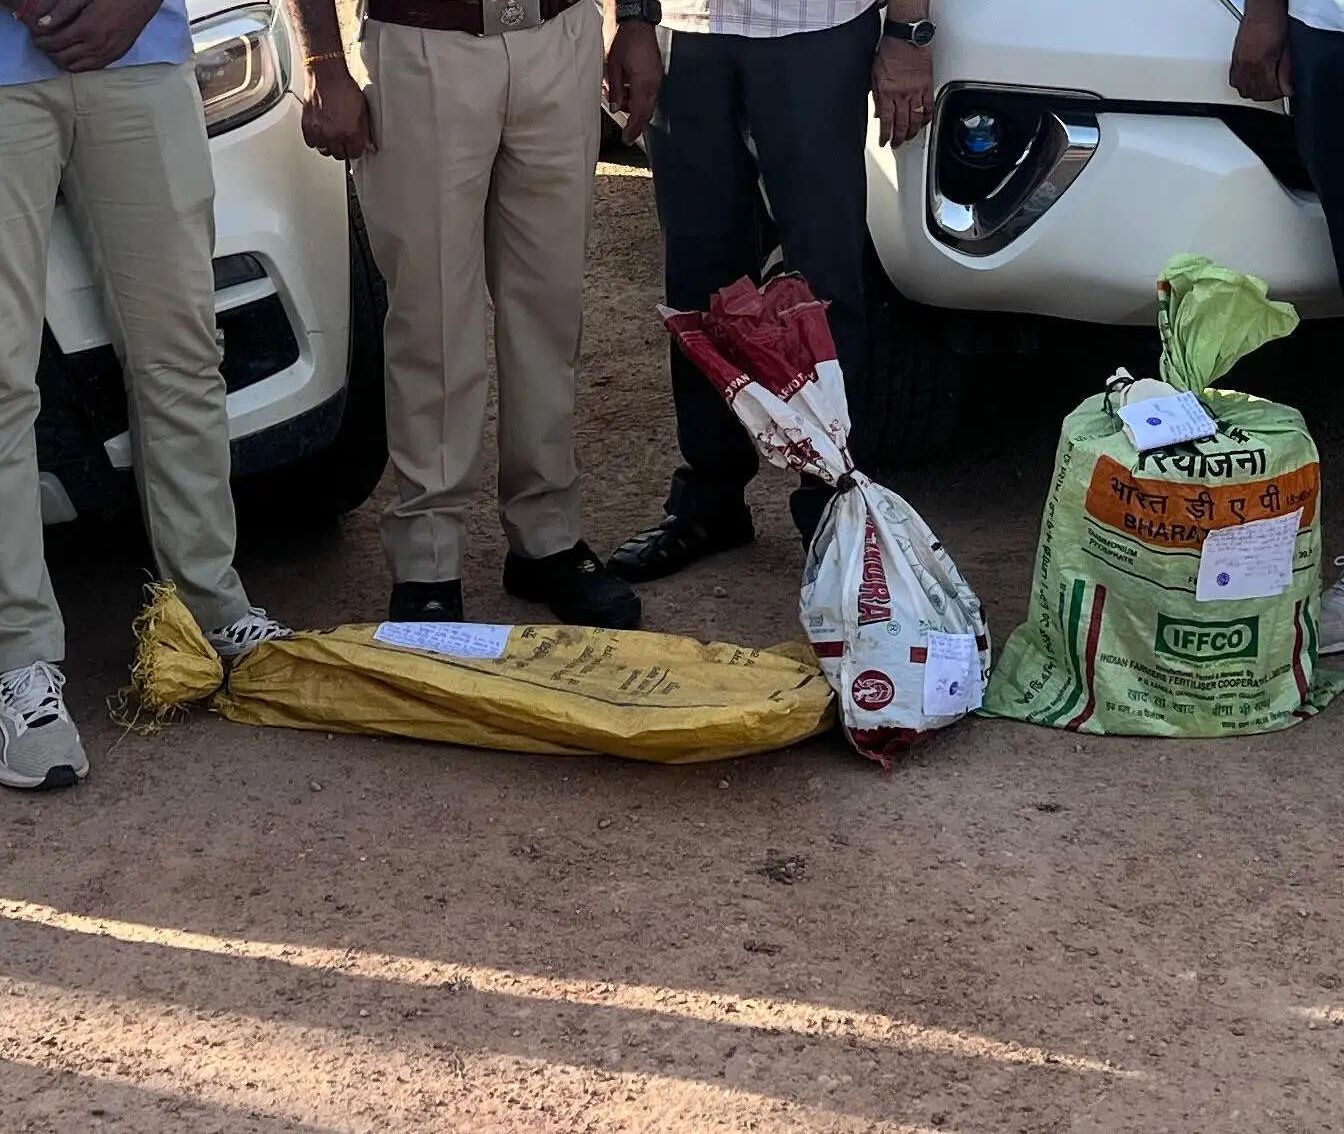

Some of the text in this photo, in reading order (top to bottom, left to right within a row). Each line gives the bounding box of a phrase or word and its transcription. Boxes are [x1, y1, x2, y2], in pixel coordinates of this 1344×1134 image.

[1111, 477, 1169, 516] भारत
[1183, 490, 1215, 521] डी
[1259, 484, 1281, 513] पी
[1172, 628, 1243, 652] IFFCO
